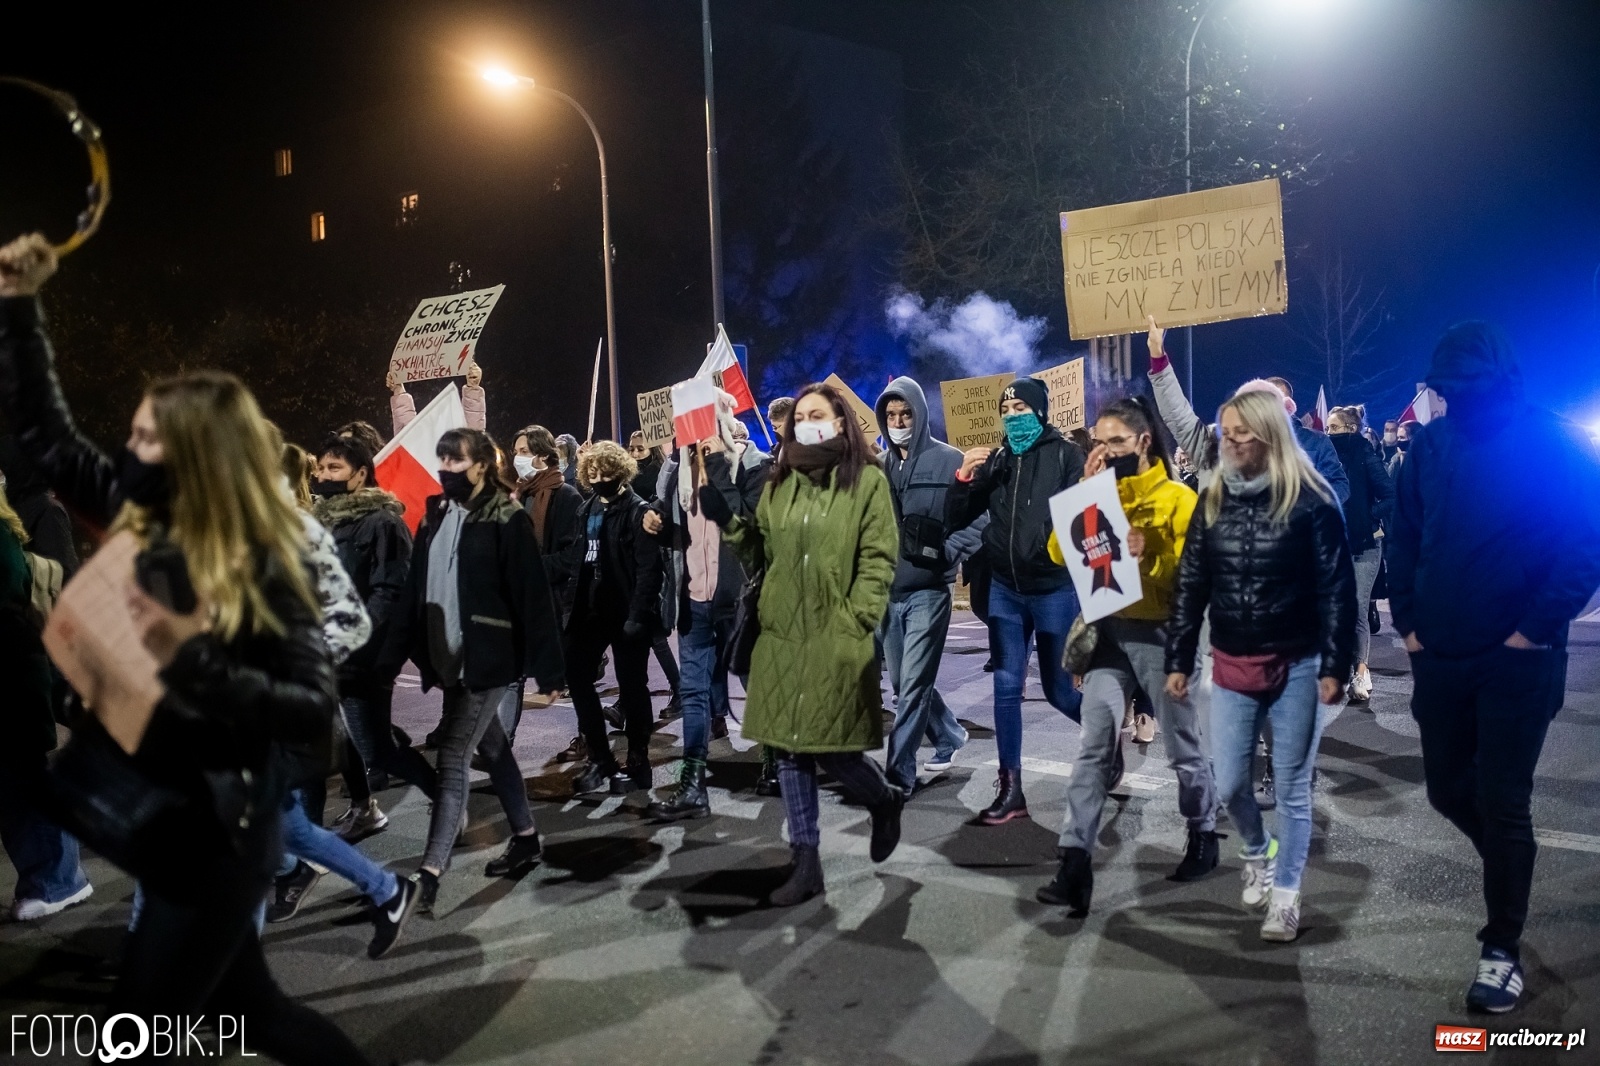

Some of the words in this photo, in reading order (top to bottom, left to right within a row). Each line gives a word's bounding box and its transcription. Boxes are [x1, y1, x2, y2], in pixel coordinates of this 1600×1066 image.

[1073, 229, 1167, 269] JESZCZE
[1176, 216, 1277, 252] POLSKA
[1075, 271, 1100, 288] NIE
[1197, 249, 1247, 271] KIEDY
[417, 293, 494, 319] CHCESZ
[1105, 287, 1148, 320] MY
[395, 335, 446, 354] FINANSUJ
[640, 389, 672, 411] JAREK
[963, 385, 991, 399] JAREK
[640, 409, 667, 425] WINA
[951, 401, 984, 416] KOBIETA
[986, 399, 997, 411] TO
[969, 416, 995, 430] JAJKO
[1081, 530, 1109, 551] STRAJK
